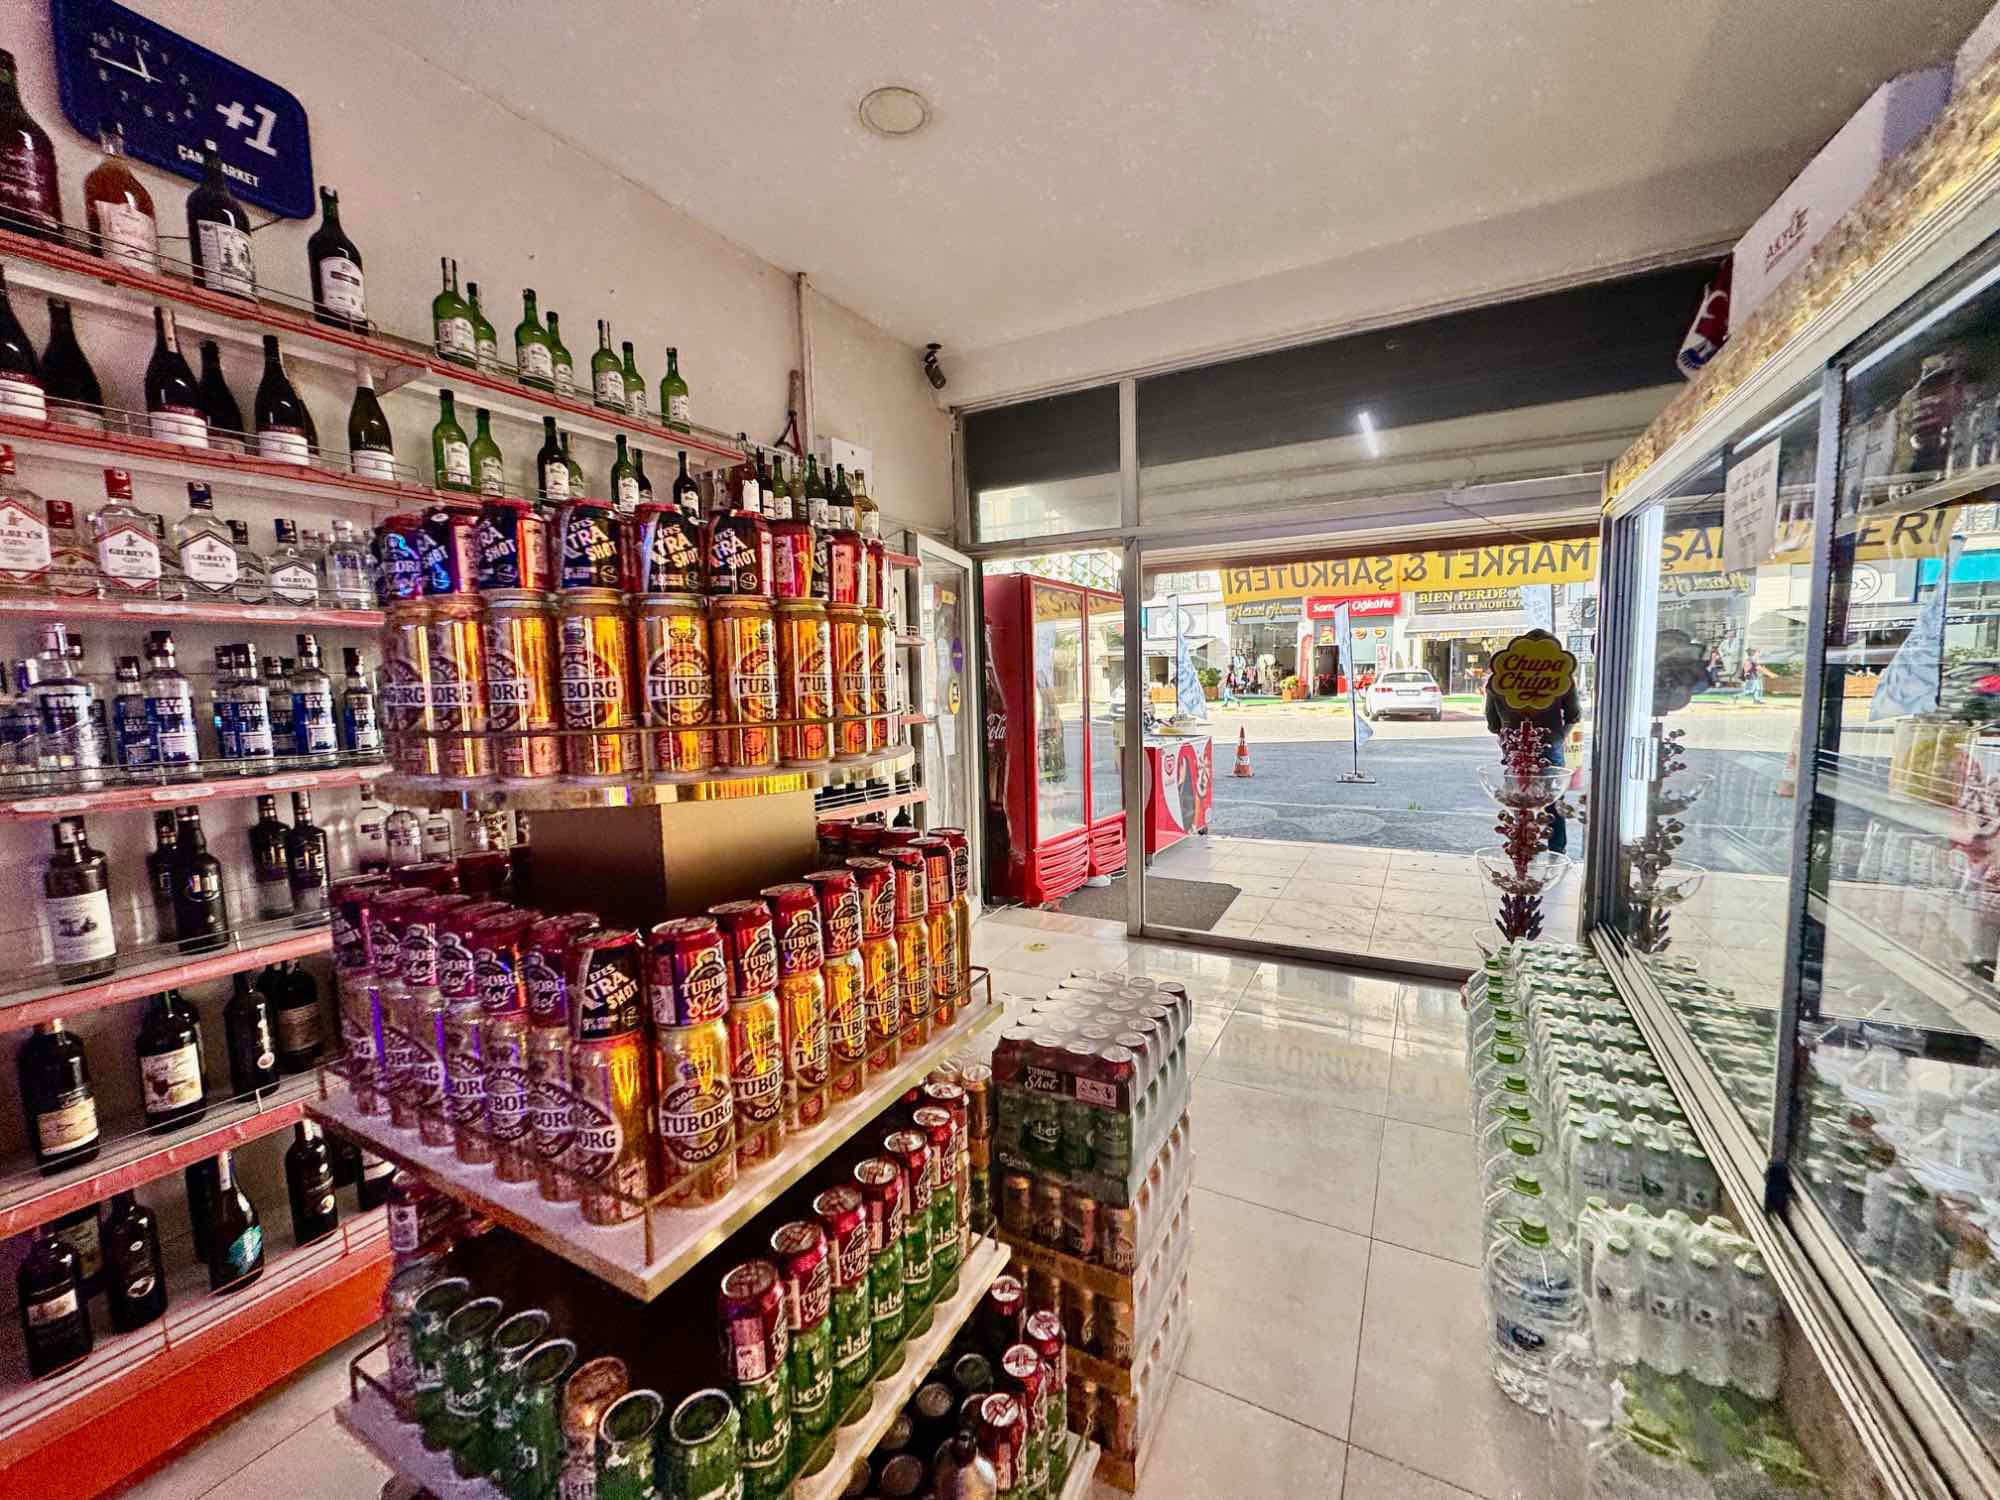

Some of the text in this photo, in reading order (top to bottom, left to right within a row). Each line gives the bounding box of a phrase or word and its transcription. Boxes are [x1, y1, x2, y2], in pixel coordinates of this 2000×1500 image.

[215, 100, 278, 157] +1
[220, 162, 259, 188] ARKET
[191, 553, 232, 562] GILBEY'S
[485, 539, 517, 562] SHOT
[585, 541, 617, 562] SHOT
[726, 549, 758, 570] SHOT
[1458, 587, 1507, 602] PERDE
[1503, 654, 1565, 672] Chupa
[1498, 671, 1560, 700] Chups
[589, 964, 617, 982] EFES
[606, 979, 639, 1010] SHOT
[1024, 1075, 1059, 1091] Shot
[663, 1100, 732, 1134] TUBORG
[684, 1142, 718, 1160] GOLD
